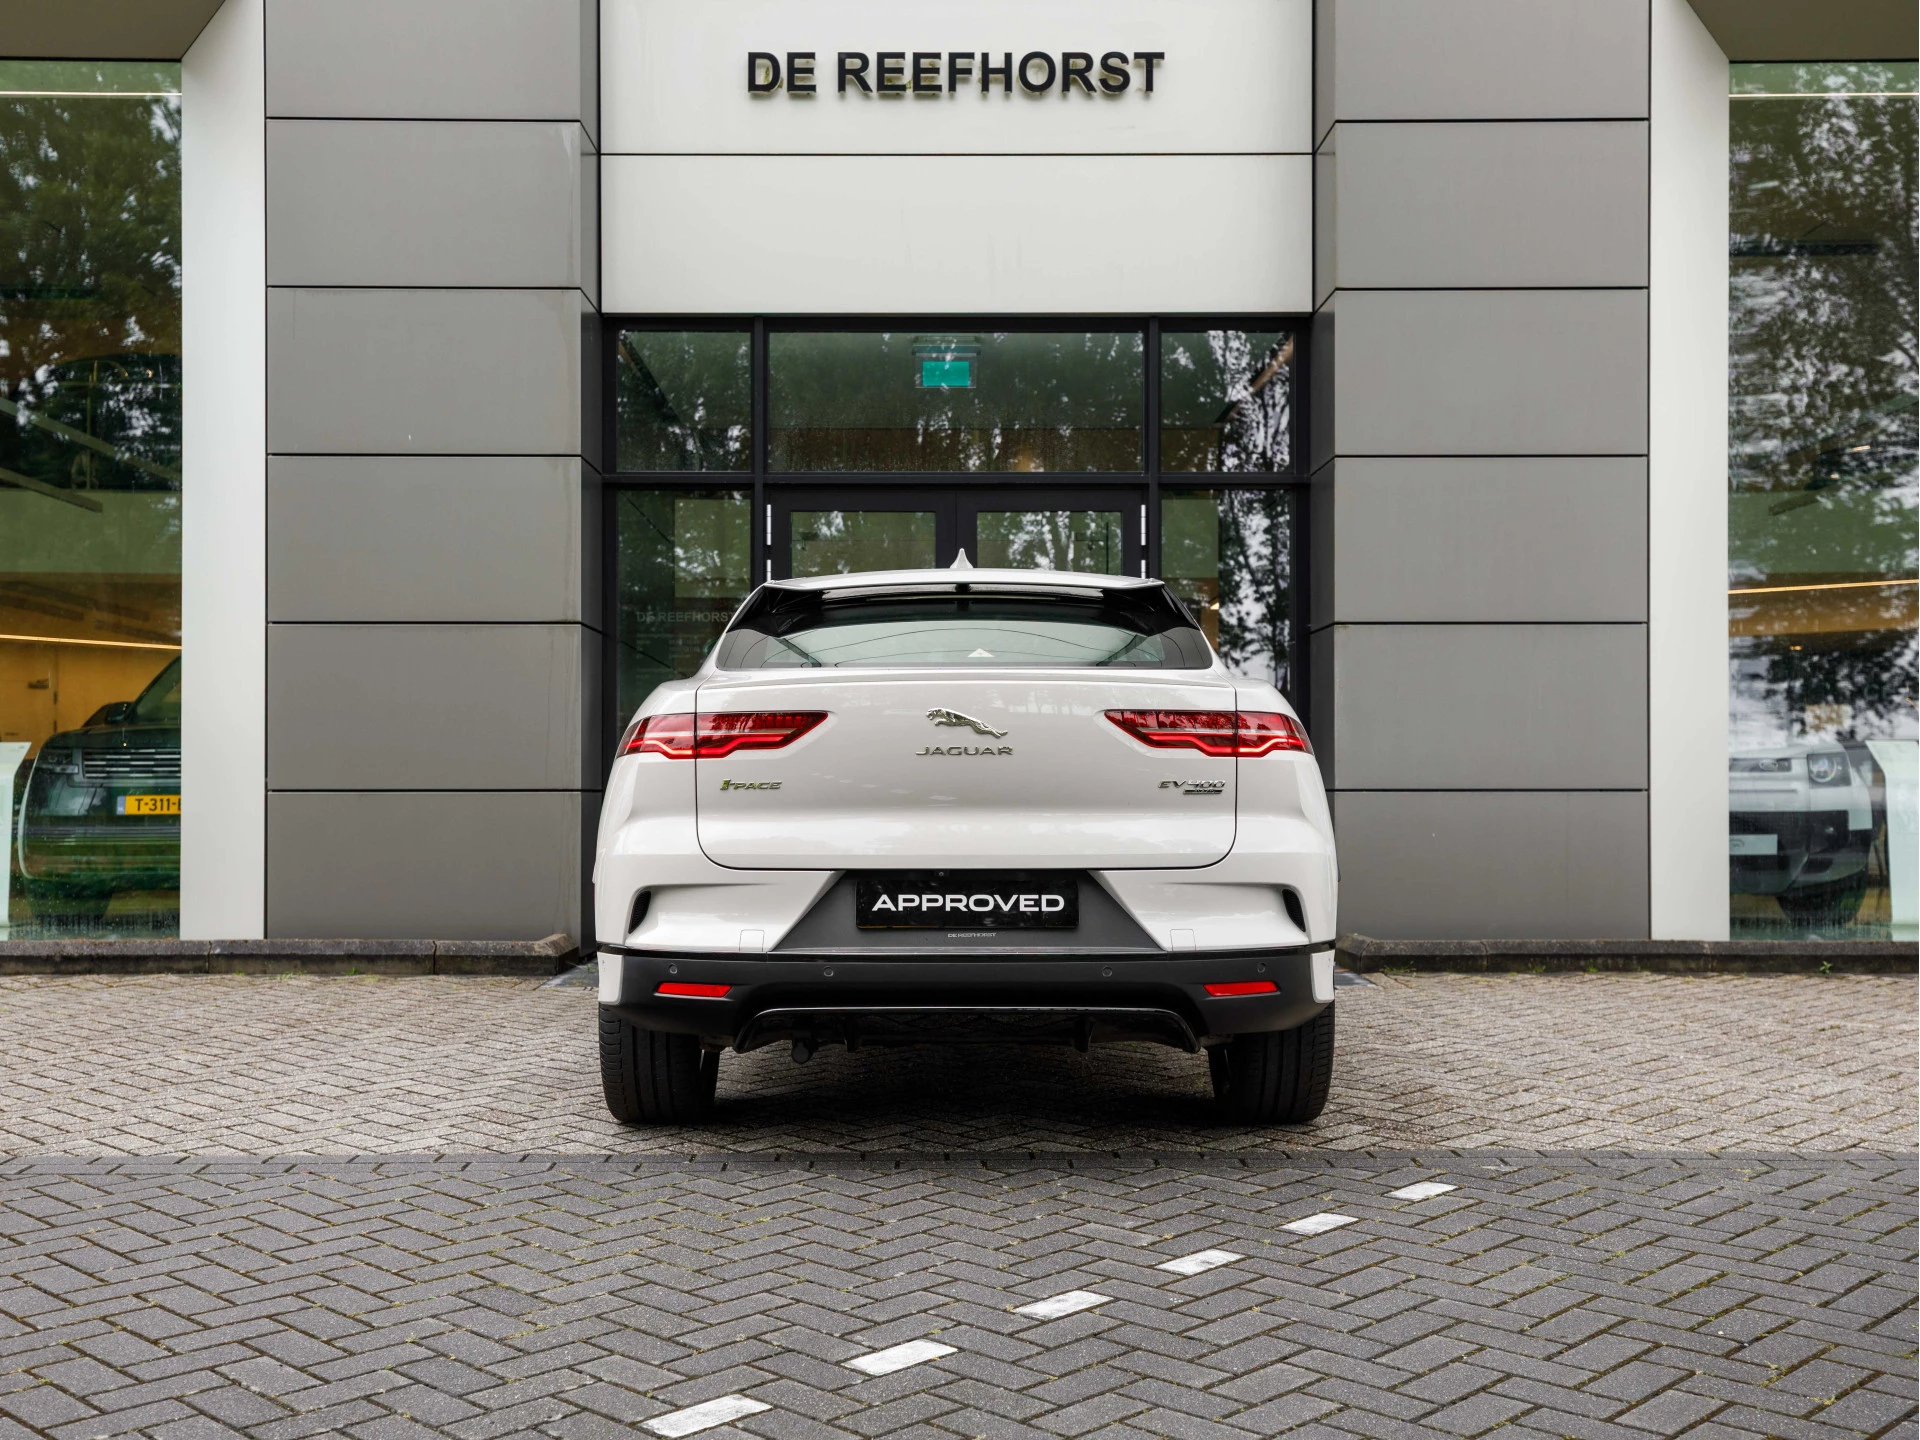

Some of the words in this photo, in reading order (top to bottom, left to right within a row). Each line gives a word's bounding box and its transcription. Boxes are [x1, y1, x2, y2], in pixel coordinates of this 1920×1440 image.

[747, 51, 817, 93] DE
[837, 51, 1165, 93] REEFHORST
[915, 746, 1014, 756] JAGUAR
[871, 894, 1065, 912] APPROVED
